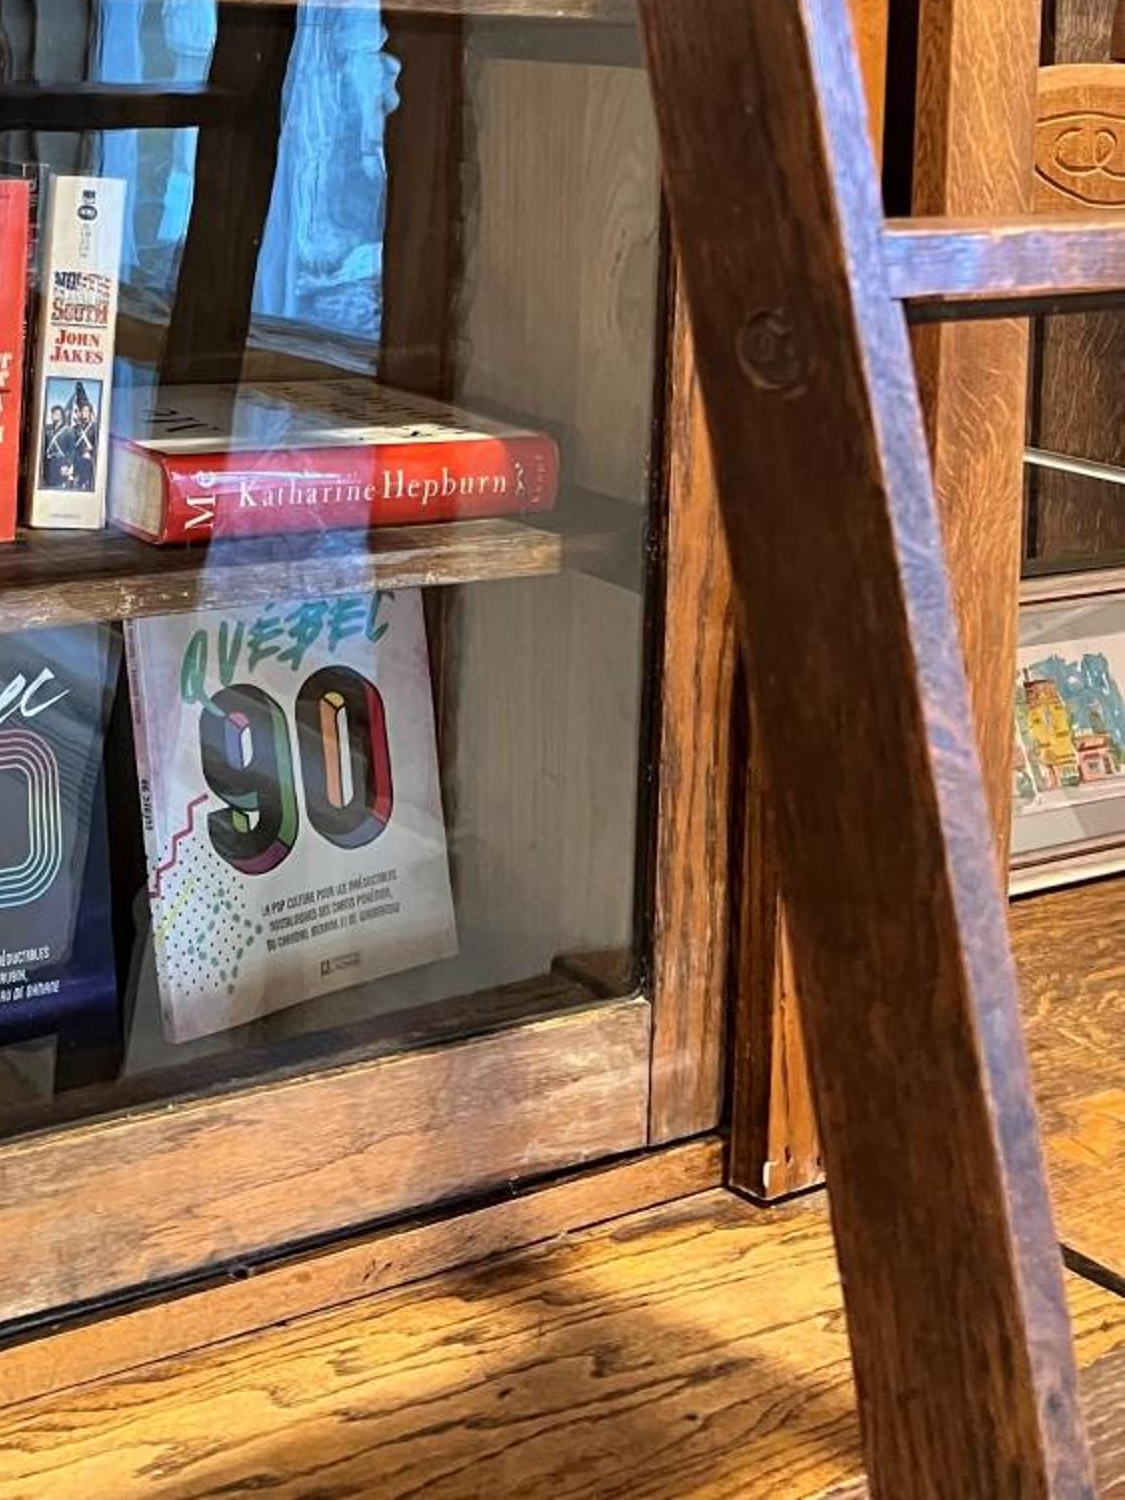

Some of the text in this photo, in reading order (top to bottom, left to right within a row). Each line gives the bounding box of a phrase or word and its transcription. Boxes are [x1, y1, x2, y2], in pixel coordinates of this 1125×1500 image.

[51, 297, 109, 324] SOUTH
[50, 346, 104, 365] JAKES
[55, 330, 100, 347] JOHN
[184, 470, 217, 533] Me
[238, 477, 376, 508] Katharine
[383, 467, 507, 506] Hepburn
[198, 665, 394, 876] 90
